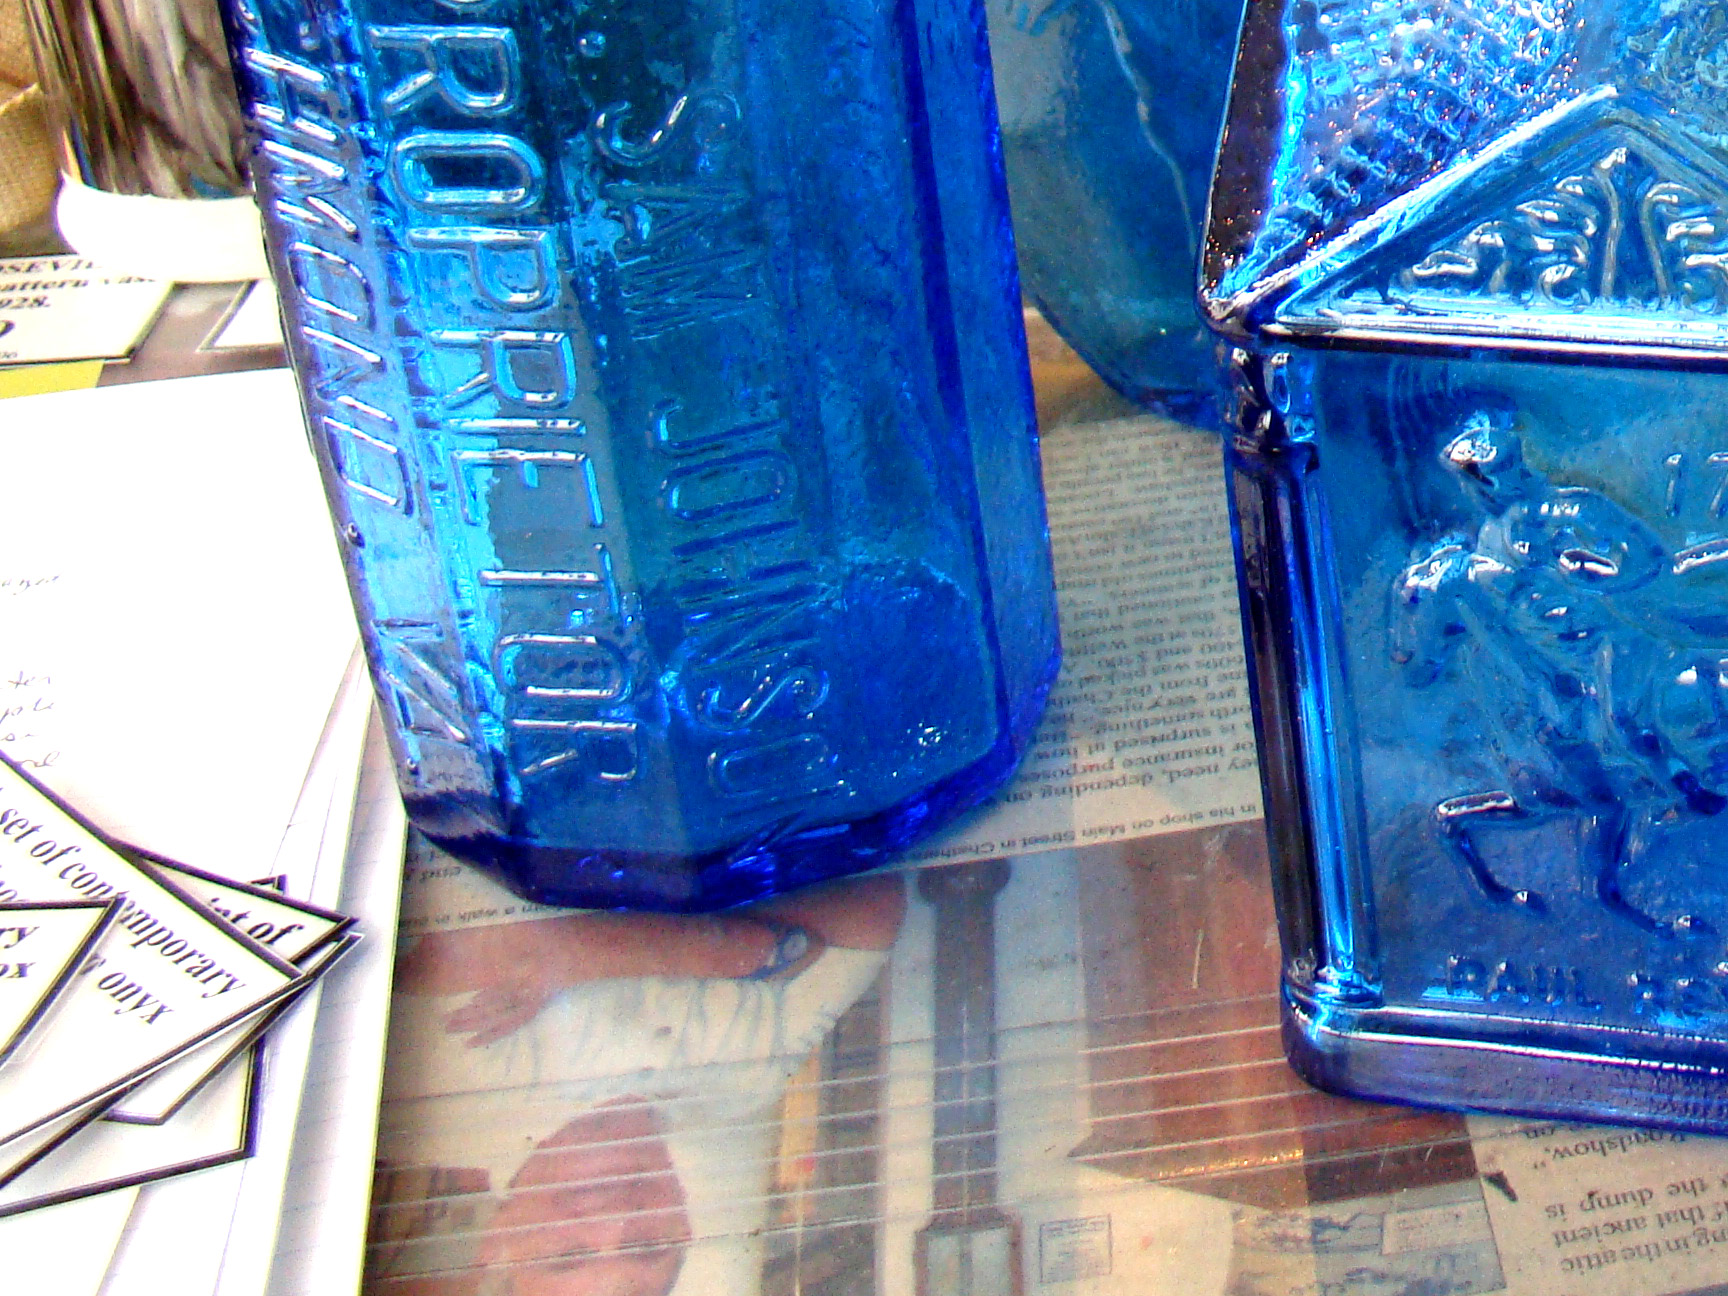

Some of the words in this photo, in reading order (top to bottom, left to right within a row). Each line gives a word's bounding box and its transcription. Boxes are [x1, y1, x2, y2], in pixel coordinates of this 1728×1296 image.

[1039, 772, 1153, 800] depending
[1131, 818, 1154, 831] on
[1159, 811, 1204, 828] shop
[1021, 830, 1076, 849] Street
[1081, 824, 1126, 841] Main
[29, 839, 82, 866] of
[97, 971, 175, 1025] onyx
[1666, 1177, 1711, 1200] the
[1545, 1202, 1566, 1222] is
[1655, 1204, 1706, 1230] that
[1552, 1214, 1649, 1250] ancient
[1619, 1239, 1664, 1263] the
[1665, 1234, 1691, 1256] in
[1560, 1246, 1619, 1277] attic
